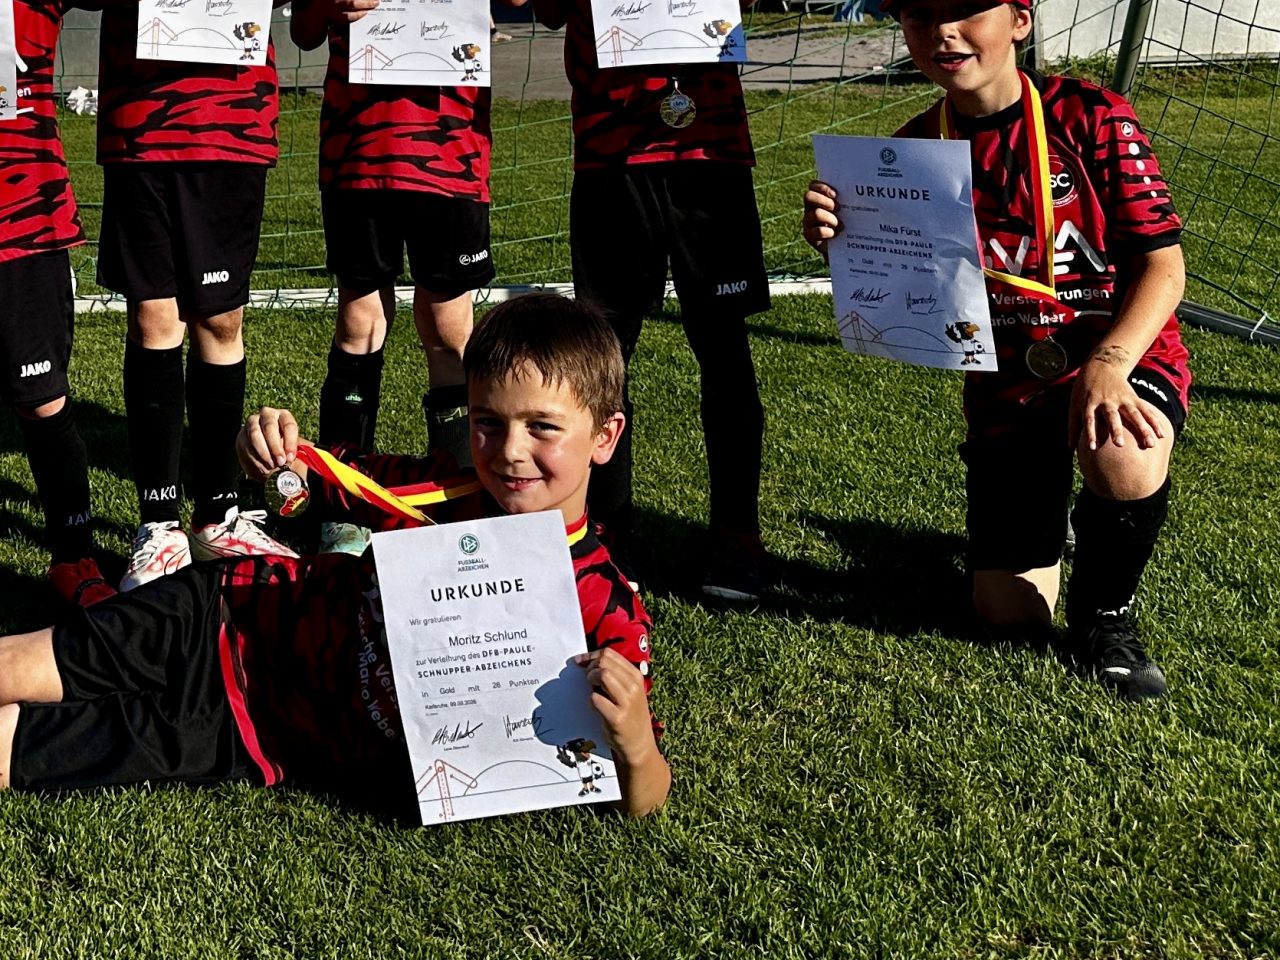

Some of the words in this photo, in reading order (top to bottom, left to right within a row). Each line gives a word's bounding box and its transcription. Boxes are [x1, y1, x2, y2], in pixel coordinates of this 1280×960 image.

[855, 185, 931, 201] URKUNDE
[879, 224, 899, 234] Mika
[900, 225, 922, 237] Fürst
[202, 270, 230, 285] JAKO
[716, 280, 748, 296] JAKO
[991, 314, 1016, 326] ario
[20, 360, 51, 378] JAKO
[1131, 377, 1169, 402] JAKO
[430, 578, 525, 602] URKUNDE
[409, 618, 422, 626] Wir
[423, 614, 462, 626] gratulieren
[449, 634, 480, 647] Moritz
[484, 628, 528, 643] Schlund
[415, 658, 427, 666] zur
[427, 652, 466, 665] Verleihung
[468, 651, 480, 659] des
[418, 658, 532, 678] SCHNUPPER-ABZEICHENS
[439, 686, 455, 695] Gold
[509, 677, 540, 689] Punkten
